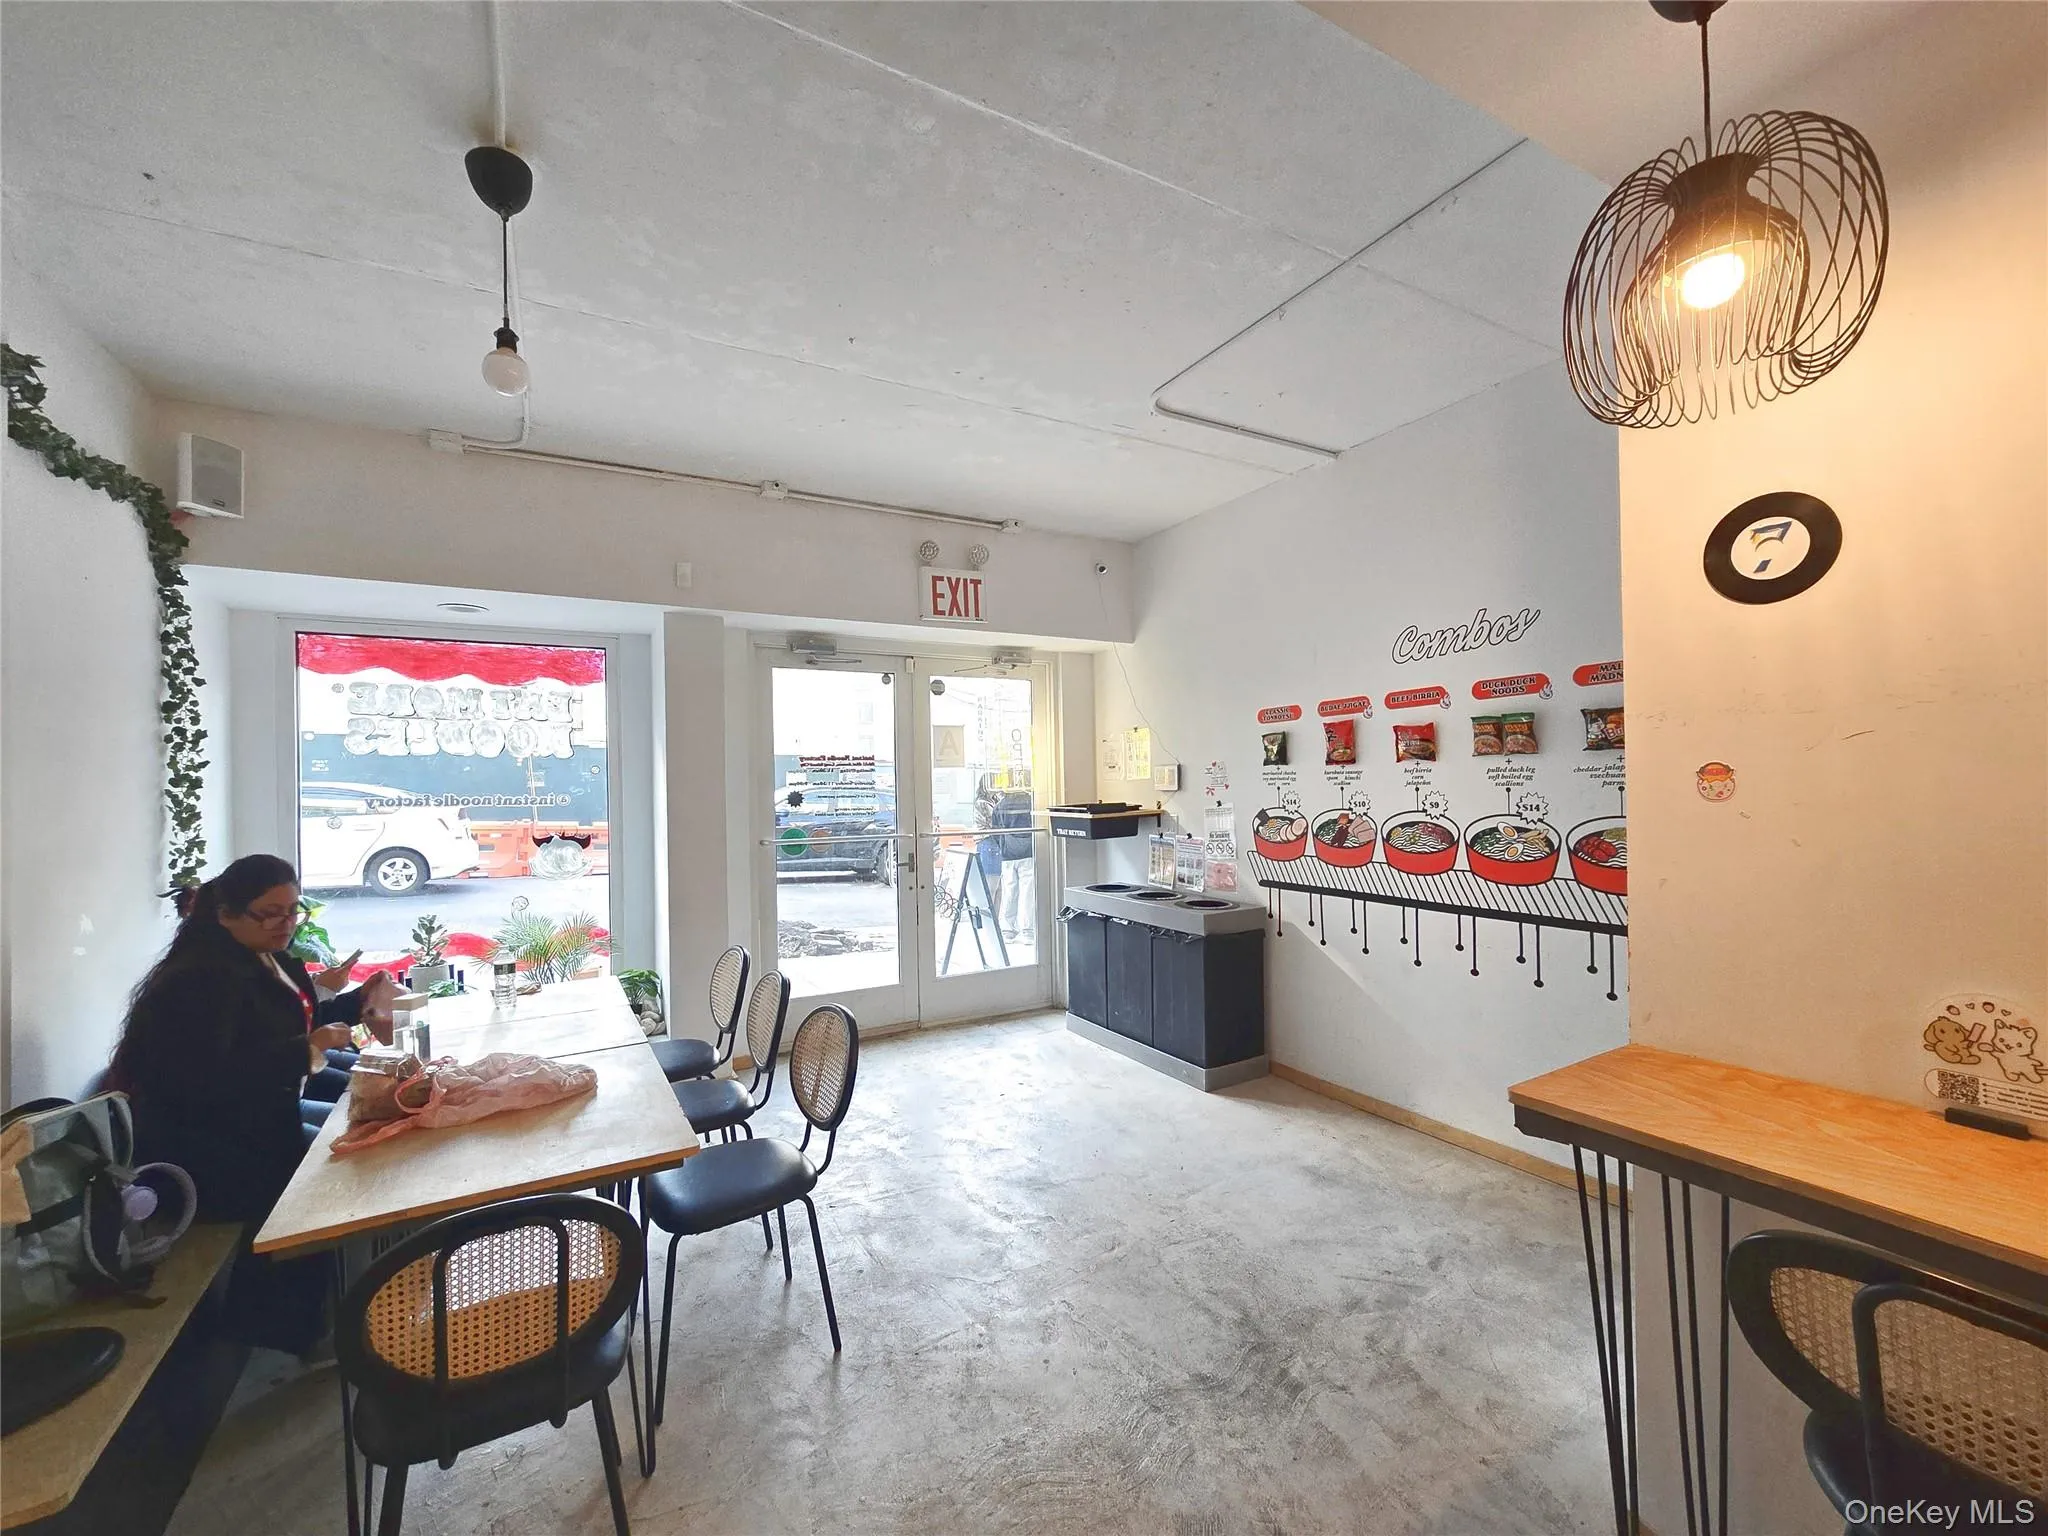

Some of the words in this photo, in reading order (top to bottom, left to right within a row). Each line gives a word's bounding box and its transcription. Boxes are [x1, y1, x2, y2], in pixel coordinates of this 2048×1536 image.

[931, 575, 982, 618] EXIT
[1391, 608, 1541, 665] Combos
[1482, 680, 1507, 690] DUCK
[1510, 677, 1536, 687] DUCK
[1491, 685, 1526, 696] NOODS
[1412, 691, 1440, 701] BIRRIA
[1404, 767, 1416, 775] beef
[1486, 766, 1507, 774] pulled
[1525, 766, 1536, 774] leg
[1488, 773, 1500, 781] soft
[1354, 800, 1366, 808] $10
[1429, 801, 1440, 809] $9
[1522, 803, 1540, 812] $14
